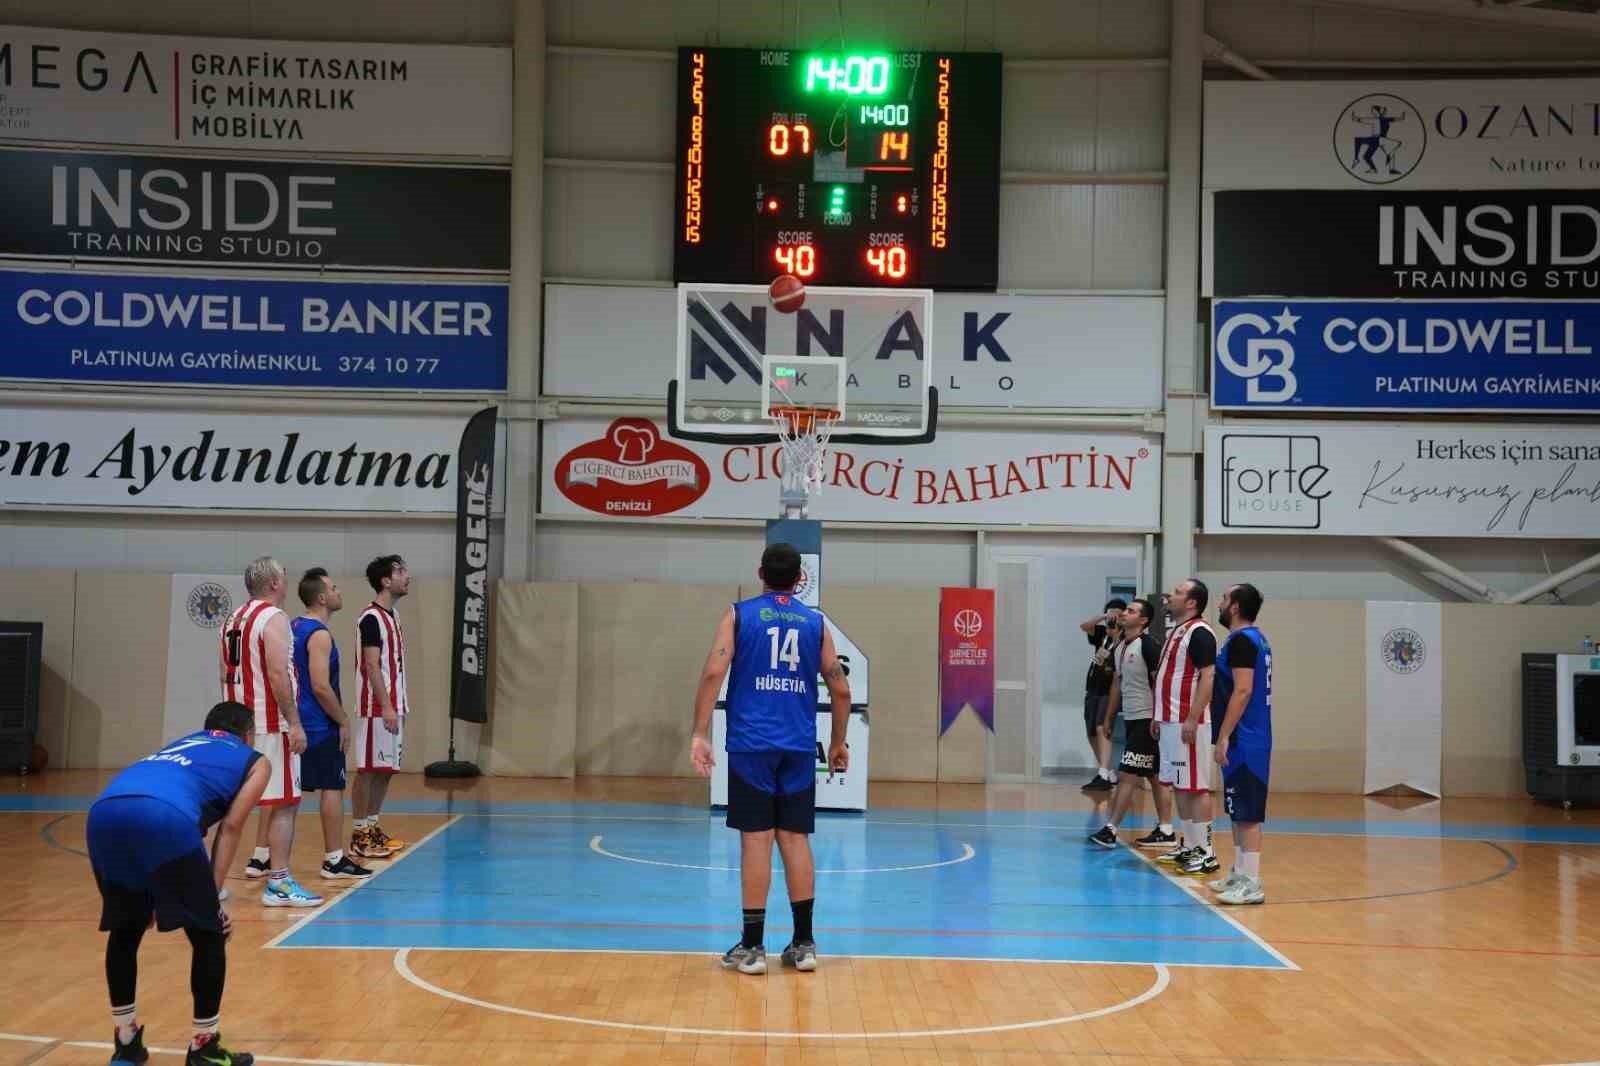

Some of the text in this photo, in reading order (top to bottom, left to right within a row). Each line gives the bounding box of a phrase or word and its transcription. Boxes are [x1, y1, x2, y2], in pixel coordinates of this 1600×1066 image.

[191, 51, 408, 82] GRAFİK TASARIM
[760, 52, 789, 66] HOME
[895, 54, 923, 68] UEST
[806, 56, 890, 94] 14:00
[191, 80, 355, 111] İÇ MİMARLIK
[191, 112, 304, 140] MOBİLYA
[860, 105, 909, 126] 14:00
[770, 125, 810, 155] 07
[880, 132, 909, 161] 14
[1488, 156, 1566, 172] Nature
[51, 165, 337, 236] INSIDE
[68, 231, 323, 258] TRAINING STUDIO
[777, 231, 814, 245] SCORE
[869, 232, 905, 247] SCORE
[1378, 205, 1600, 266] INSID
[775, 246, 815, 276] 40
[867, 247, 907, 278] 40
[1394, 269, 1599, 289] TRAINING STU
[16, 288, 493, 337] COLDWELL BANKER
[1322, 317, 1593, 355] COLDWELL
[71, 348, 440, 374] PLATINUM GAYRİMENKUL 374 10 77
[795, 371, 1014, 392] KABLO
[1376, 376, 1477, 394] PLATINUM
[85, 427, 451, 495] Aydınlatma
[1416, 438, 1496, 460] Herkes
[1501, 440, 1543, 466] için
[722, 445, 905, 500] CIRCİ
[605, 498, 652, 511] DENİZLİ
[1237, 498, 1304, 512] HOUSE
[1358, 460, 1521, 532] Kusursuz
[766, 626, 801, 672] 14
